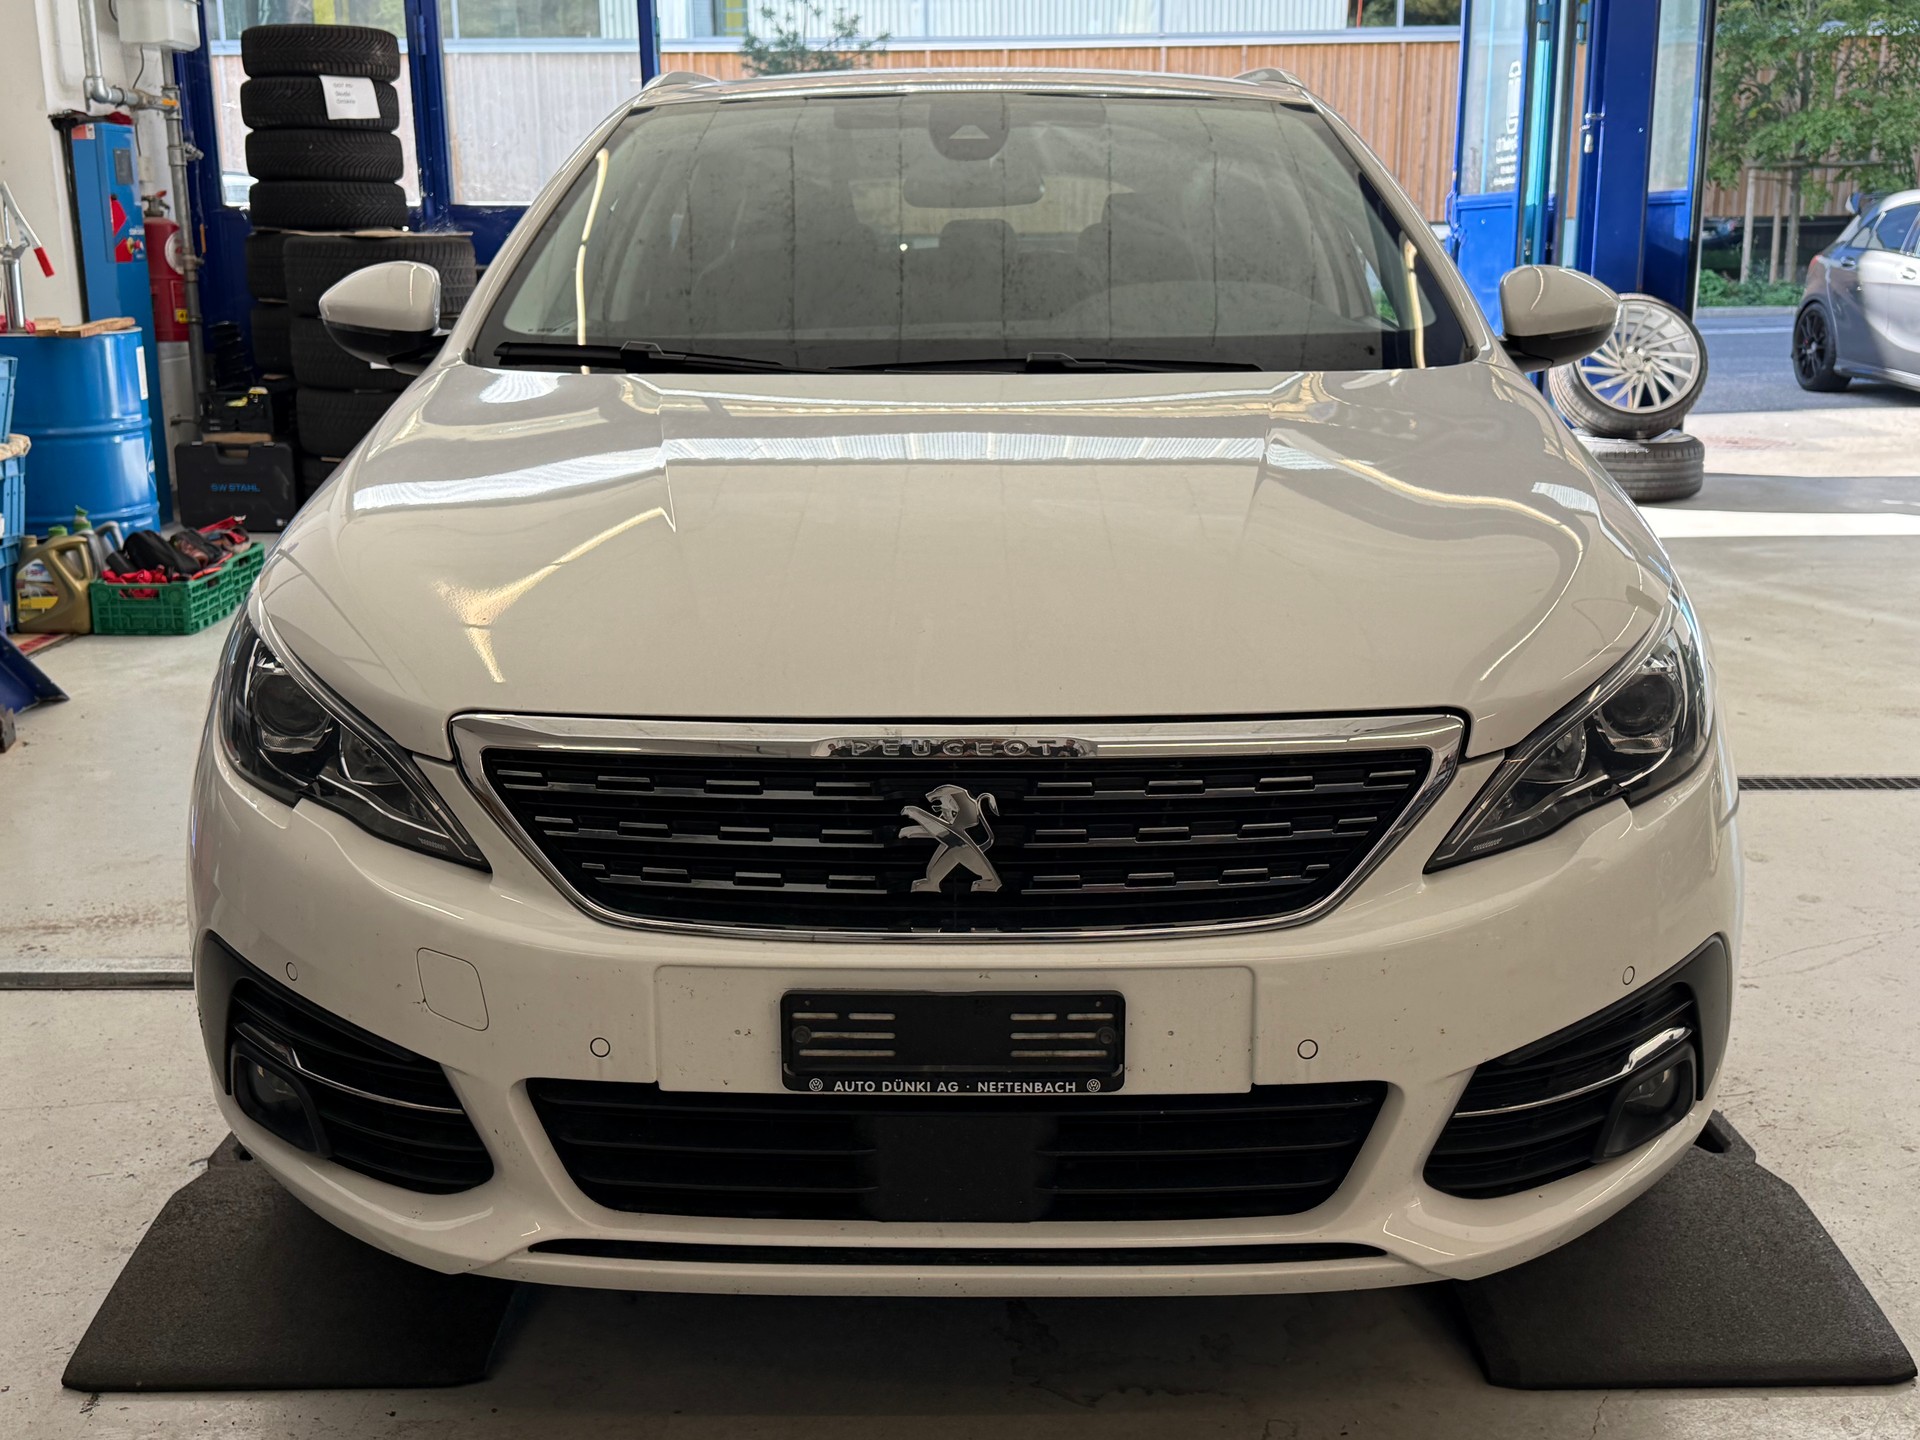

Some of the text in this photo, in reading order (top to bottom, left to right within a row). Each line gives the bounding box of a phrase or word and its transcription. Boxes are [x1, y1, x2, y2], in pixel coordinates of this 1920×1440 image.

[229, 483, 261, 493] STAHL
[851, 739, 1057, 757] PEUGEOT
[833, 1078, 1077, 1094] AUTO DÜNKI AG NEFTENBACH
